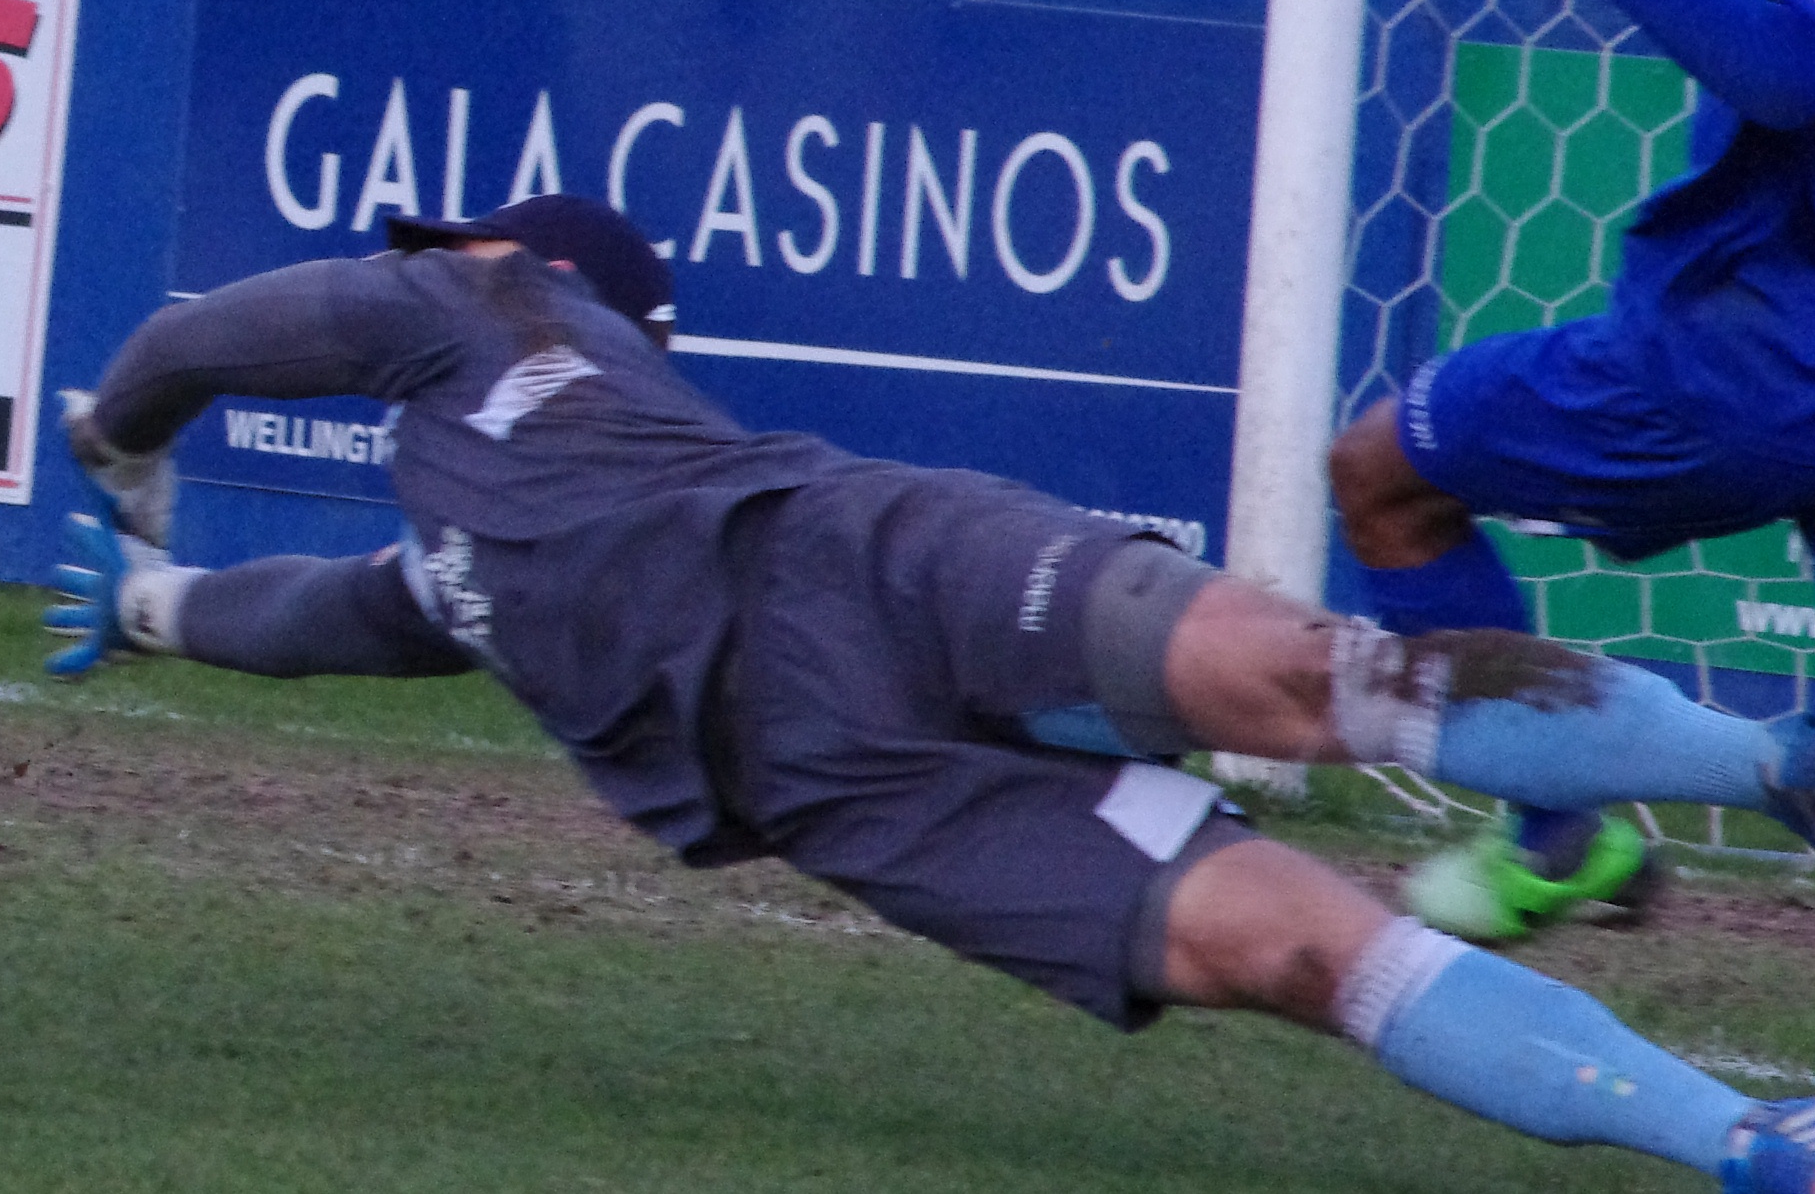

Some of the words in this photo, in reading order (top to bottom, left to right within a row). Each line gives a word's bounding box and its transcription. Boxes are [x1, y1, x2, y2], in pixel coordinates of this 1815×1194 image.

[264, 70, 564, 234] GALA
[607, 102, 1172, 303] CASINOS
[225, 407, 400, 467] WELLINGT
